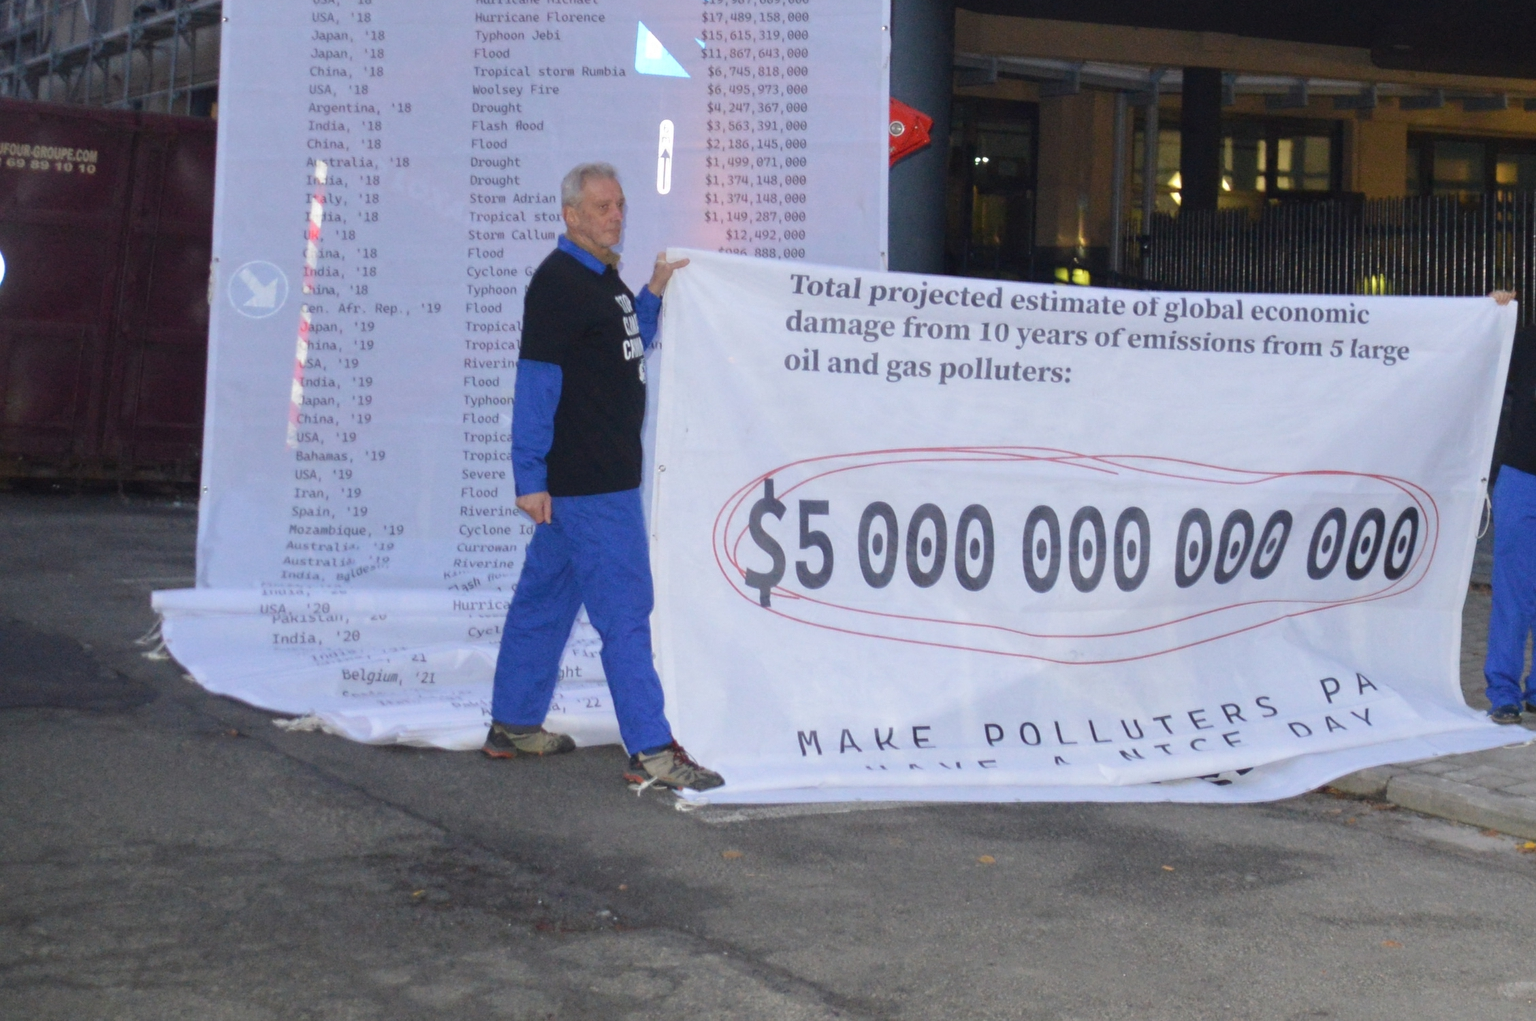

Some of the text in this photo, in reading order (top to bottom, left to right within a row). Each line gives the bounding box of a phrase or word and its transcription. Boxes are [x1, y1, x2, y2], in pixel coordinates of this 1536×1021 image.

[311, 11, 810, 25] USA, '18 Hurricane Florence $17,489,158,000
[309, 65, 809, 79] China, '18 Tropical storm Rumbia $6,745,818,000
[55, 162, 73, 172] 10
[79, 164, 97, 174] 10
[790, 274, 1370, 325] Total projected estimate of global economic
[785, 309, 1411, 366] damage from 10 years of emissions from 5 large
[784, 348, 1072, 385] oil and gas polluters:
[296, 413, 500, 426] China, '19 Flood
[295, 450, 387, 463] Bahamas, '19
[291, 505, 520, 519] Spain, '19 Riverine
[288, 524, 512, 538] Mozambique, '19 Cyclone
[745, 479, 1419, 607] $5 000 000 000 000
[307, 603, 331, 614] '20
[272, 630, 361, 646] India, '20
[342, 668, 403, 686] Belgium,
[797, 672, 1379, 757] MAKE POLLUTERS PA
[1288, 707, 1375, 739] DAY
